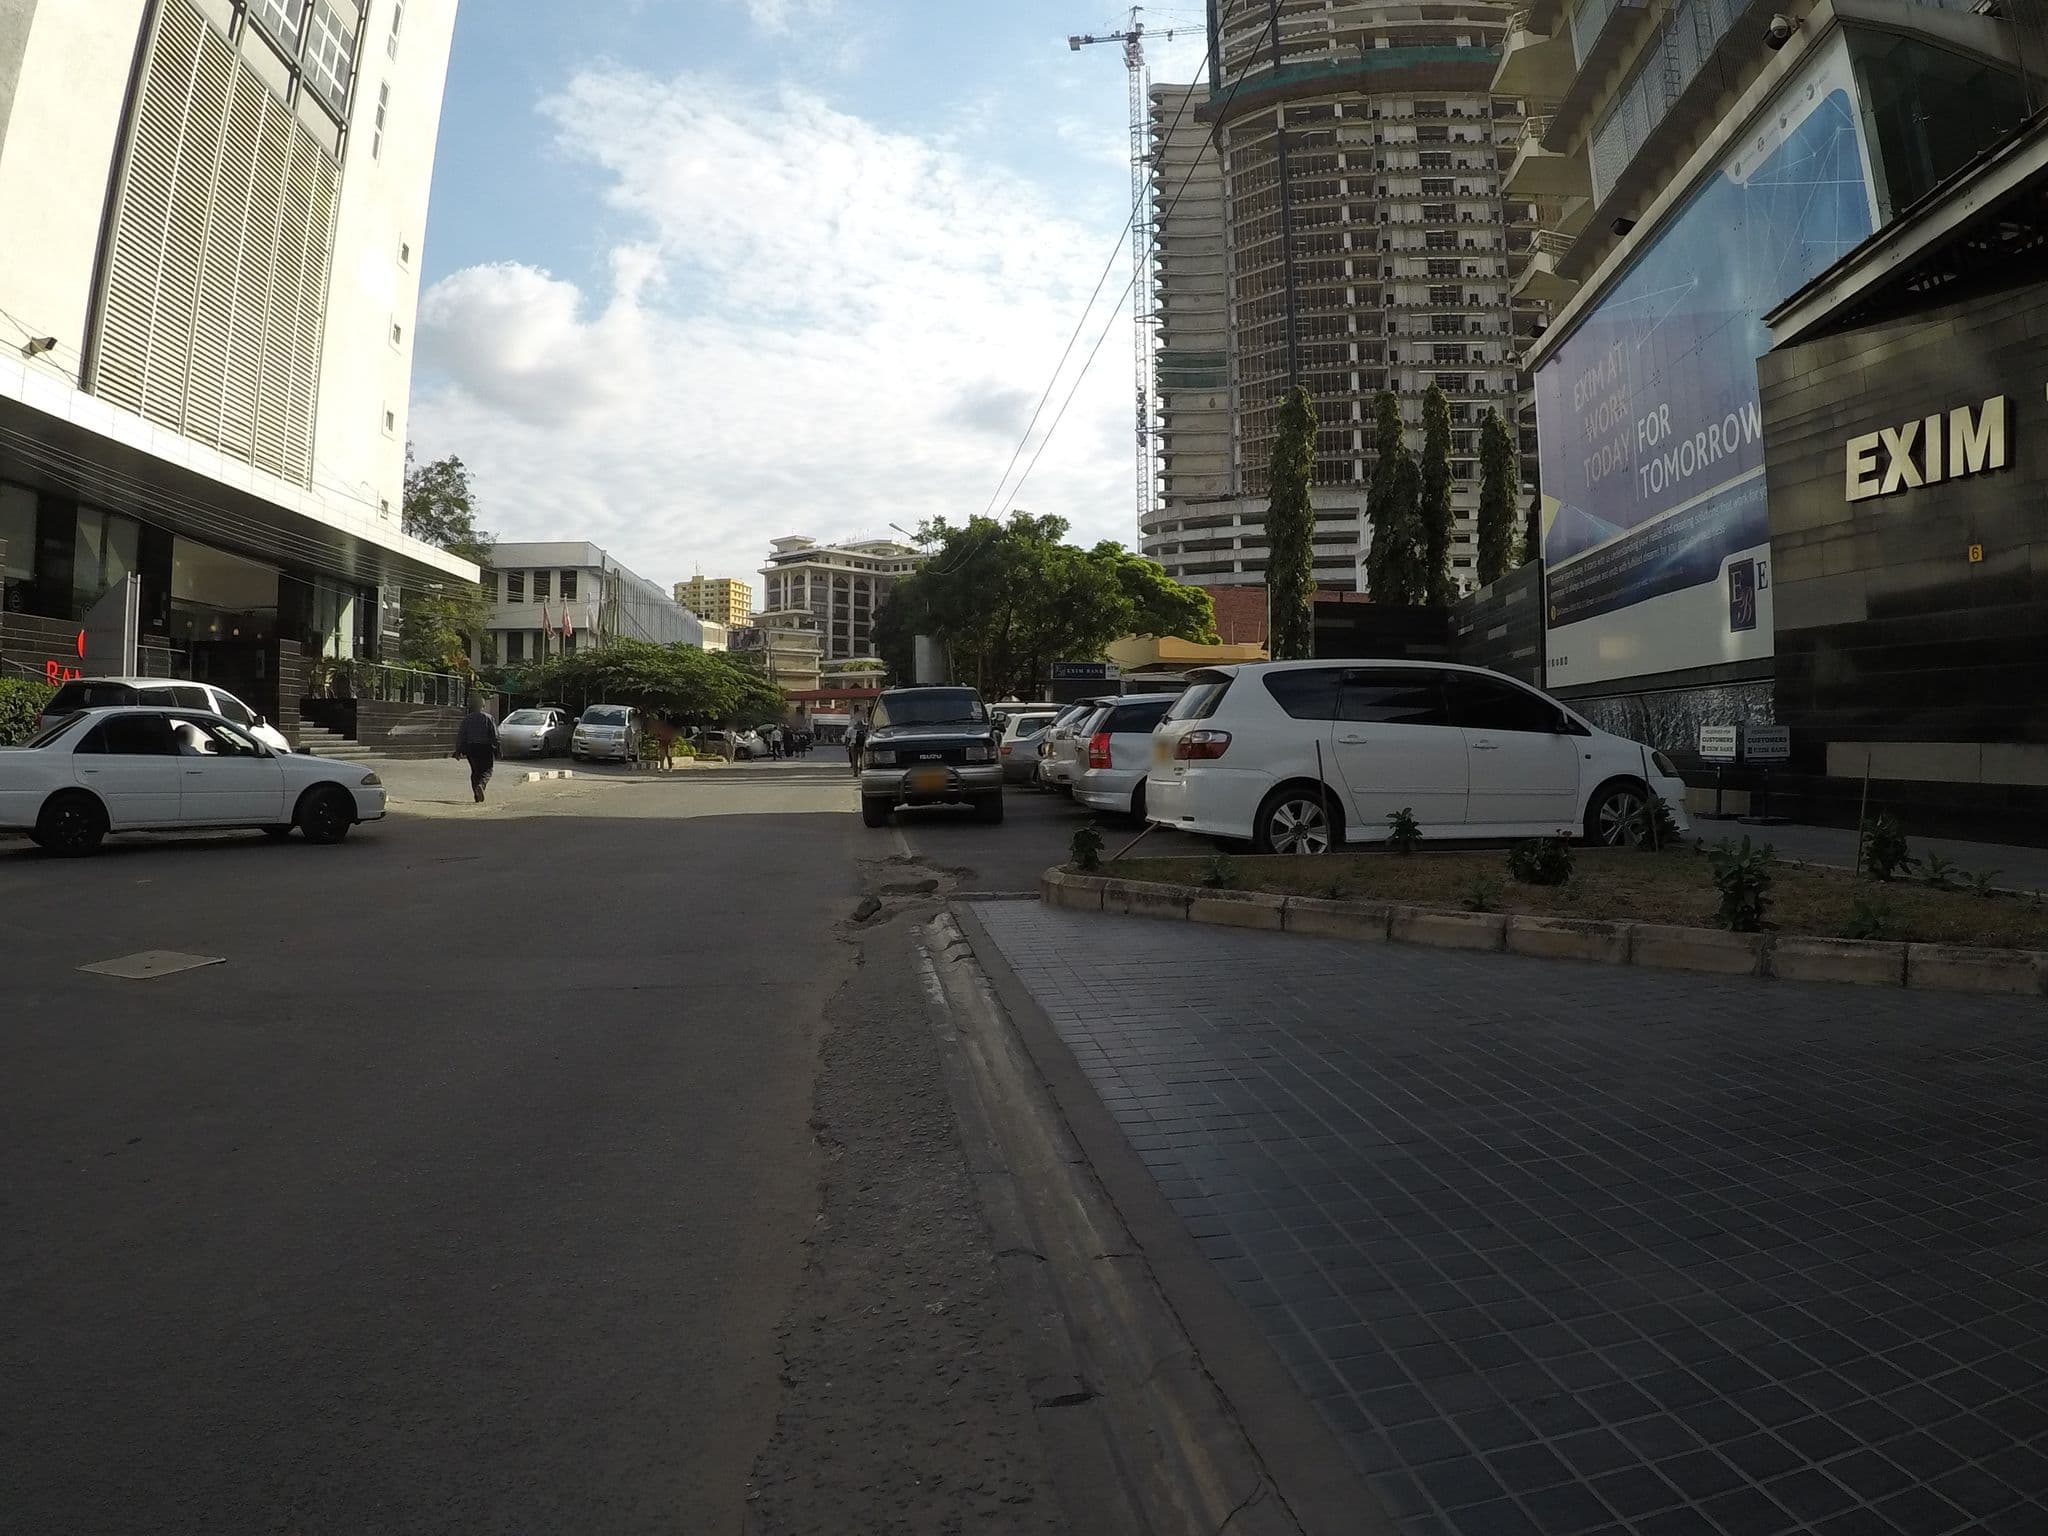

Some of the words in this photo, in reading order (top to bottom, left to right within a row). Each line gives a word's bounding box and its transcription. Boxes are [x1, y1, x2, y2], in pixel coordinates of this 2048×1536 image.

[1574, 364, 1605, 412] EXIM
[1607, 341, 1625, 384] AT
[1584, 384, 1630, 443] WORK
[1637, 402, 1672, 453] FOR
[1583, 428, 1631, 488] TODAY
[1640, 400, 1762, 498] TOMORROW
[1846, 394, 2005, 502] EXIM
[1971, 547, 1980, 560] 6
[1747, 736, 1788, 744] CUSTOMERS
